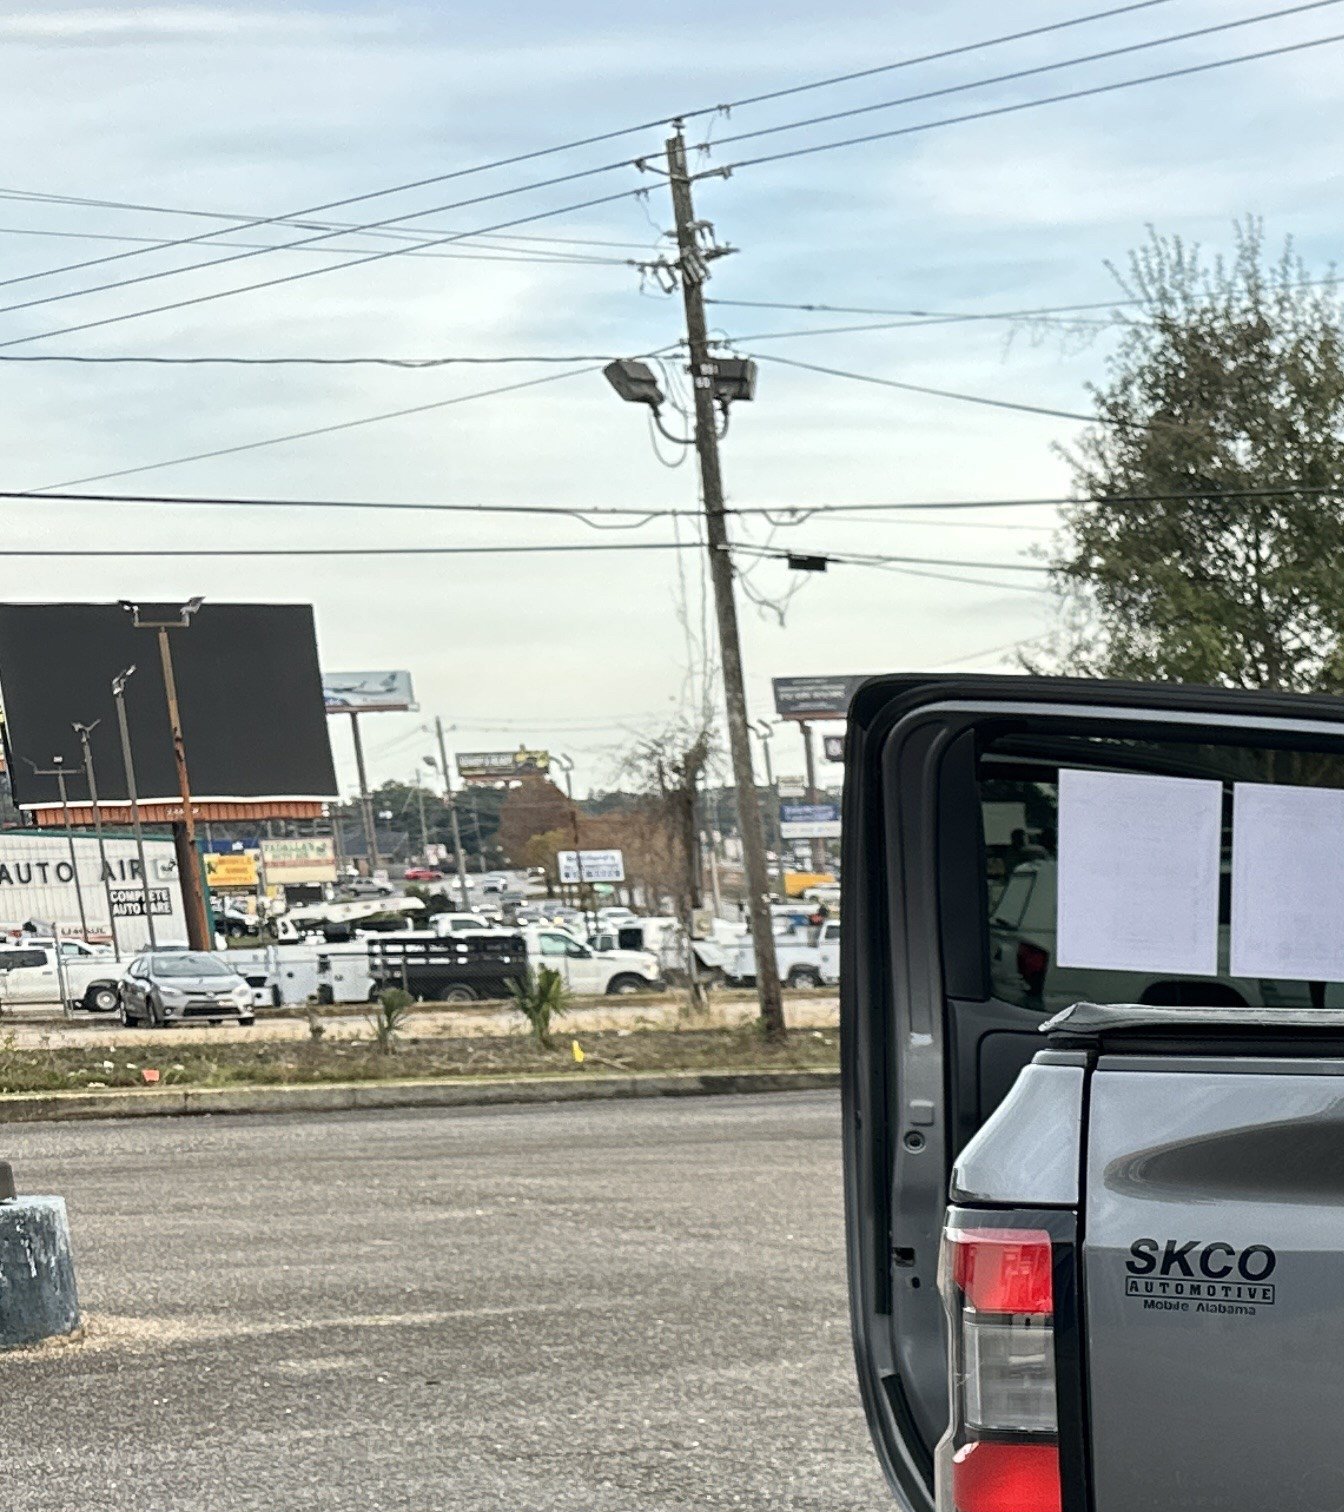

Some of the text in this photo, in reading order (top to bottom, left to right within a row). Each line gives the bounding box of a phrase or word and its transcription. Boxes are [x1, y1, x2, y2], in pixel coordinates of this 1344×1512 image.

[0, 859, 143, 884] AUTO AIR
[113, 902, 141, 915] AUTO
[1125, 1238, 1277, 1281] SKCO
[1128, 1280, 1272, 1301] AUTOMOTIVE
[1143, 1299, 1257, 1316] Mobile Alabama
